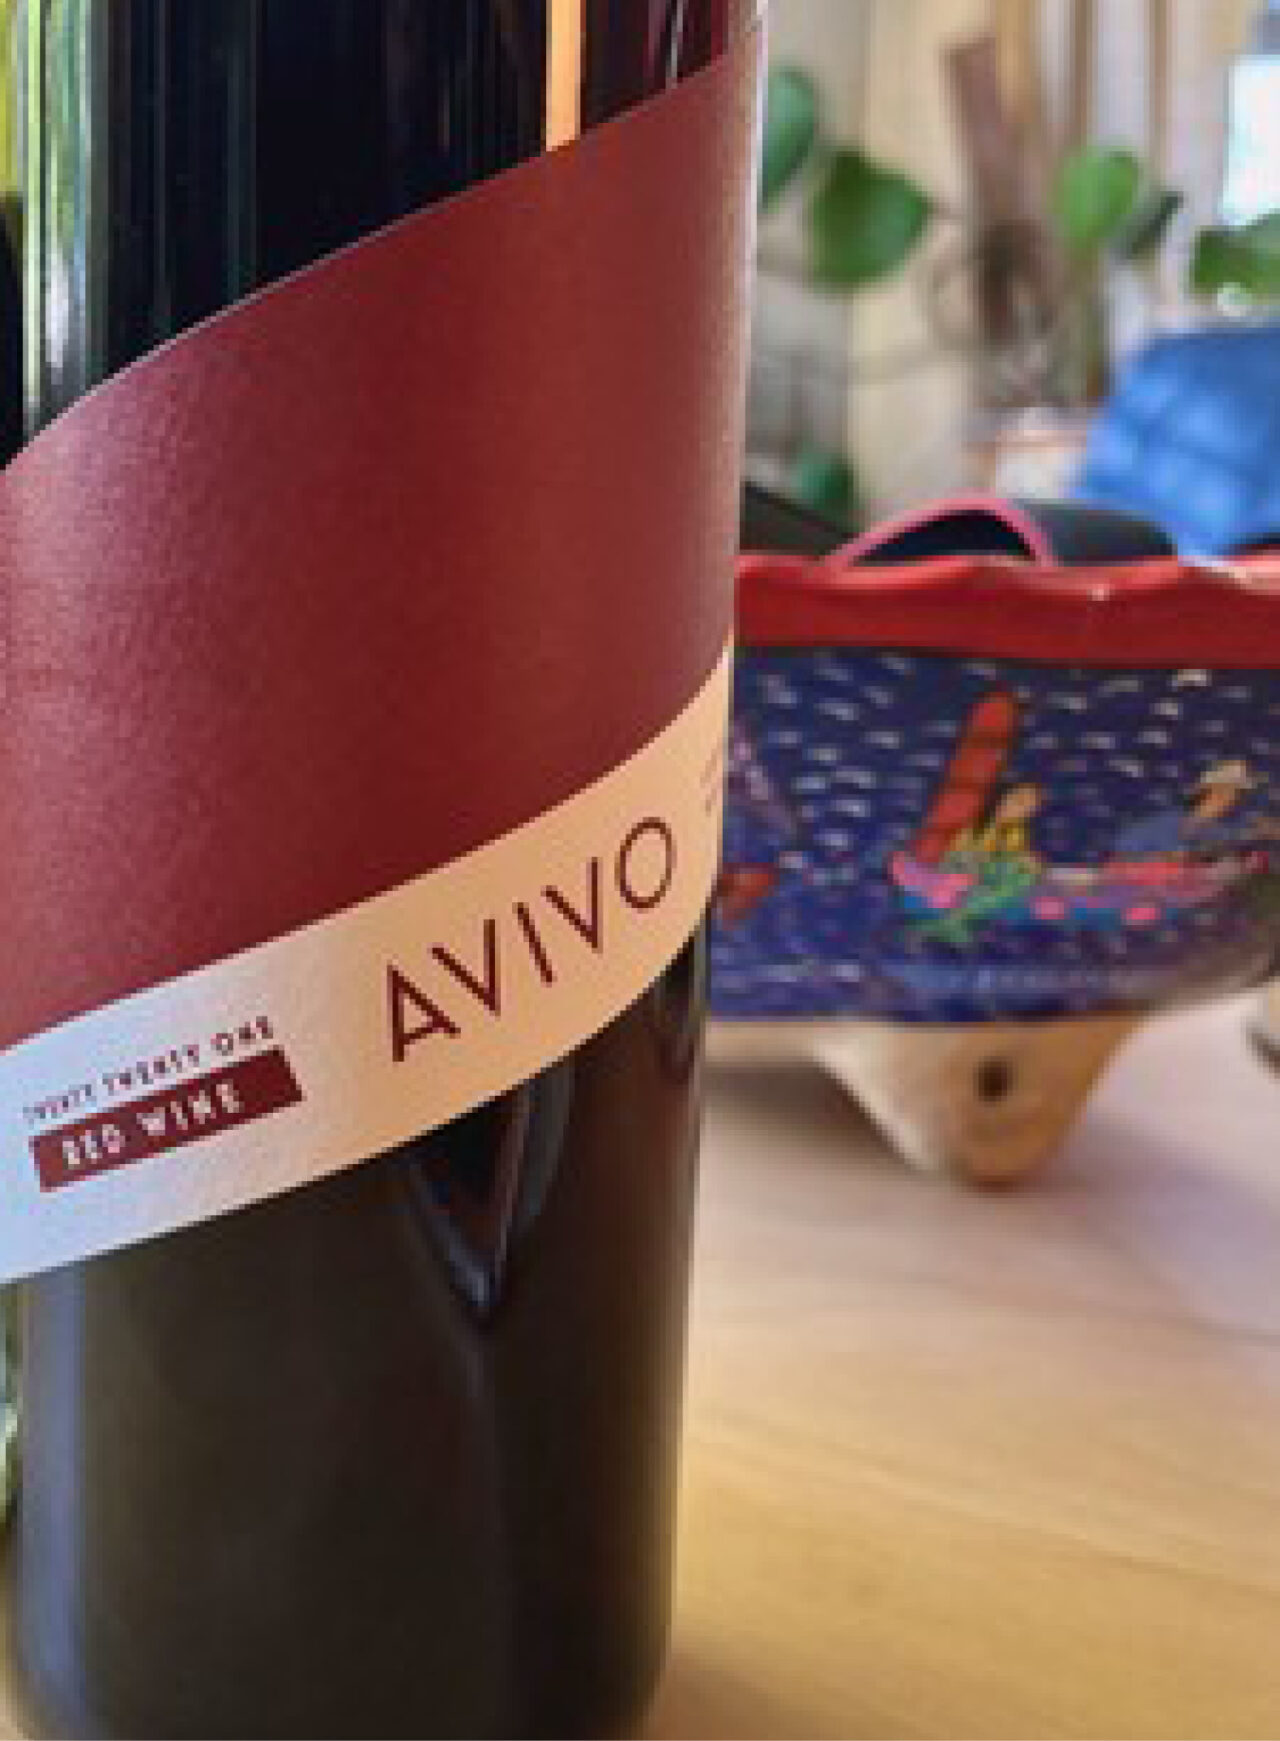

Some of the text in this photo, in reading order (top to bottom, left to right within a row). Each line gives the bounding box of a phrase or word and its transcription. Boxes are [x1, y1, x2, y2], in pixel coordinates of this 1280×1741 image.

[387, 815, 677, 1063] AVIVO
[102, 1044, 200, 1096] TWENTY
[209, 1015, 274, 1056] ONE
[61, 1080, 245, 1171] RED WINE
